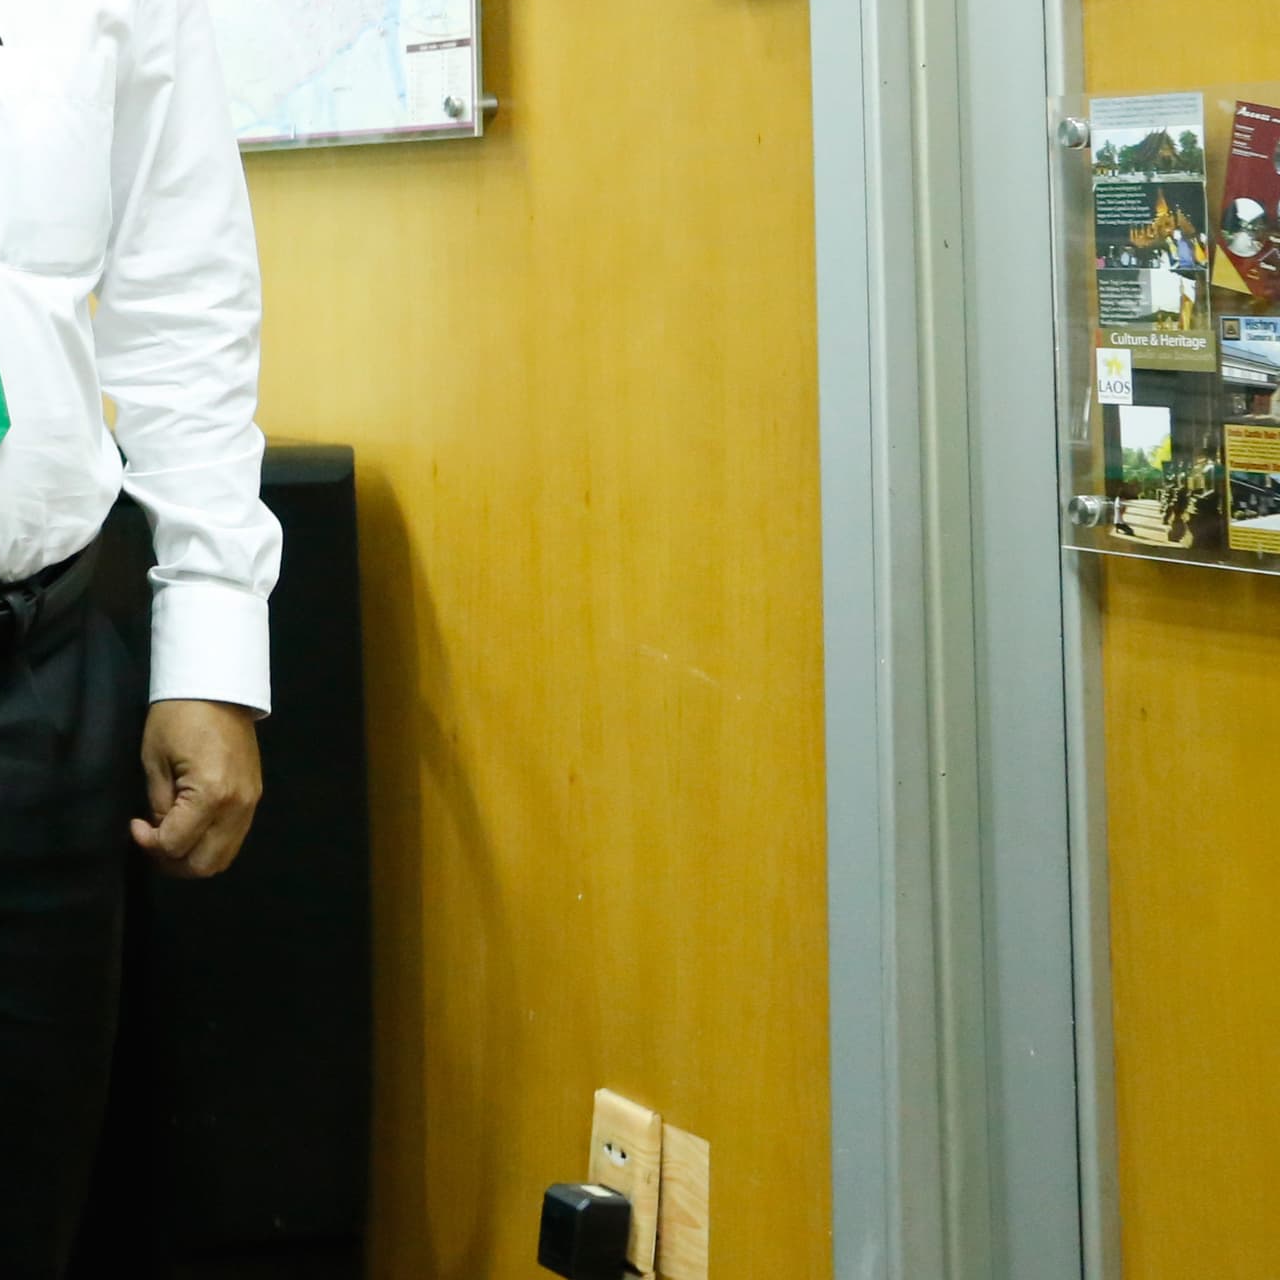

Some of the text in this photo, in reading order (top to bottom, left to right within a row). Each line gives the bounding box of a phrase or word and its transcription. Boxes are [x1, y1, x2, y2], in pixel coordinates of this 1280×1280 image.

[1110, 332, 1148, 346] Culture
[1160, 334, 1207, 350] Heritage
[1098, 380, 1131, 394] LAOS
